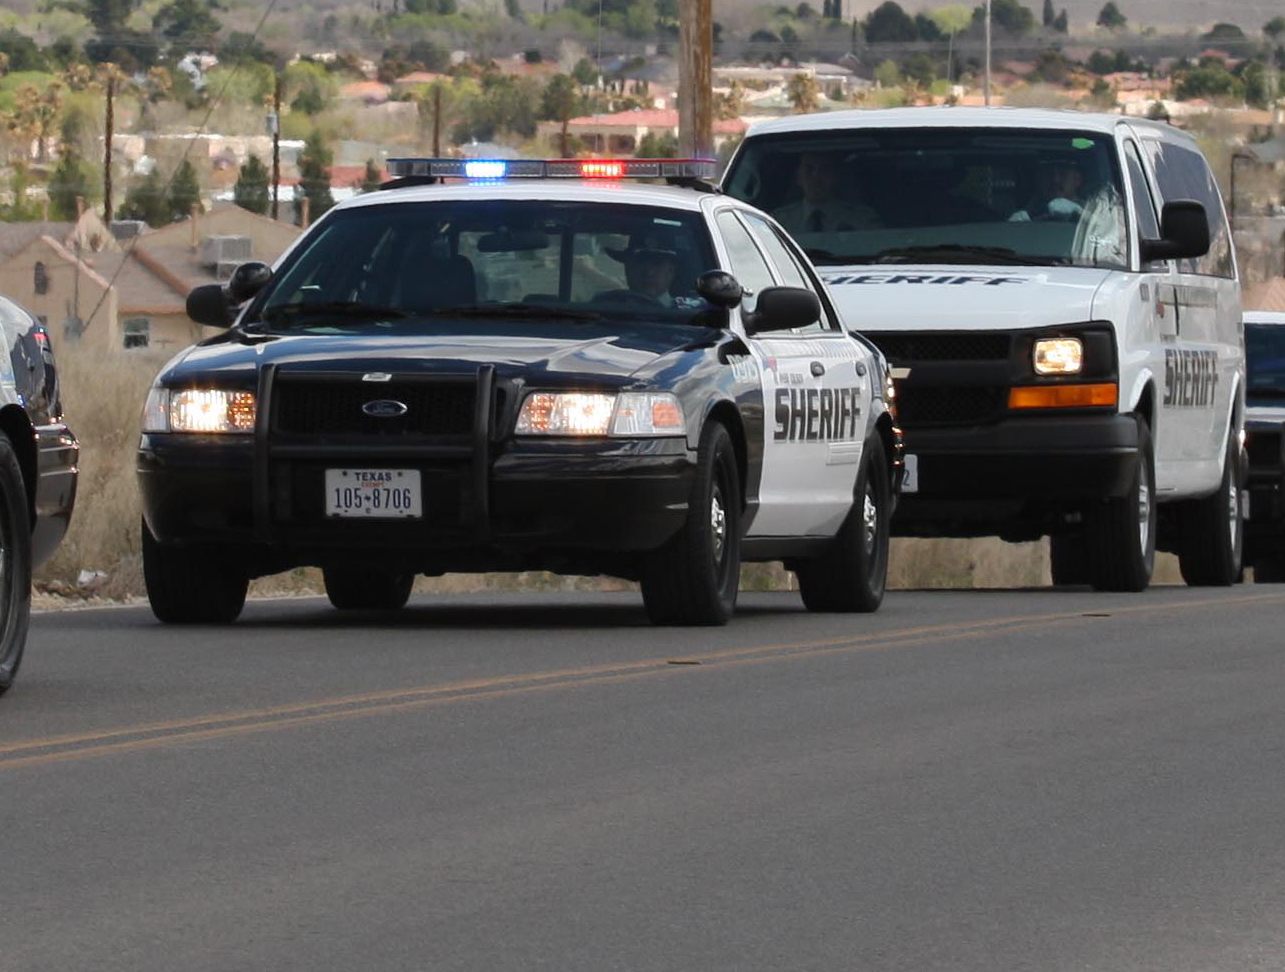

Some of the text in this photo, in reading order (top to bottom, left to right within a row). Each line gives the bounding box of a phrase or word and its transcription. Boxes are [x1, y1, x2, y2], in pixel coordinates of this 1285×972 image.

[823, 275, 1028, 286] HERIFF
[1162, 348, 1219, 406] SHERIFF
[773, 387, 861, 442] SHERIFF
[355, 471, 392, 481] TEXAS
